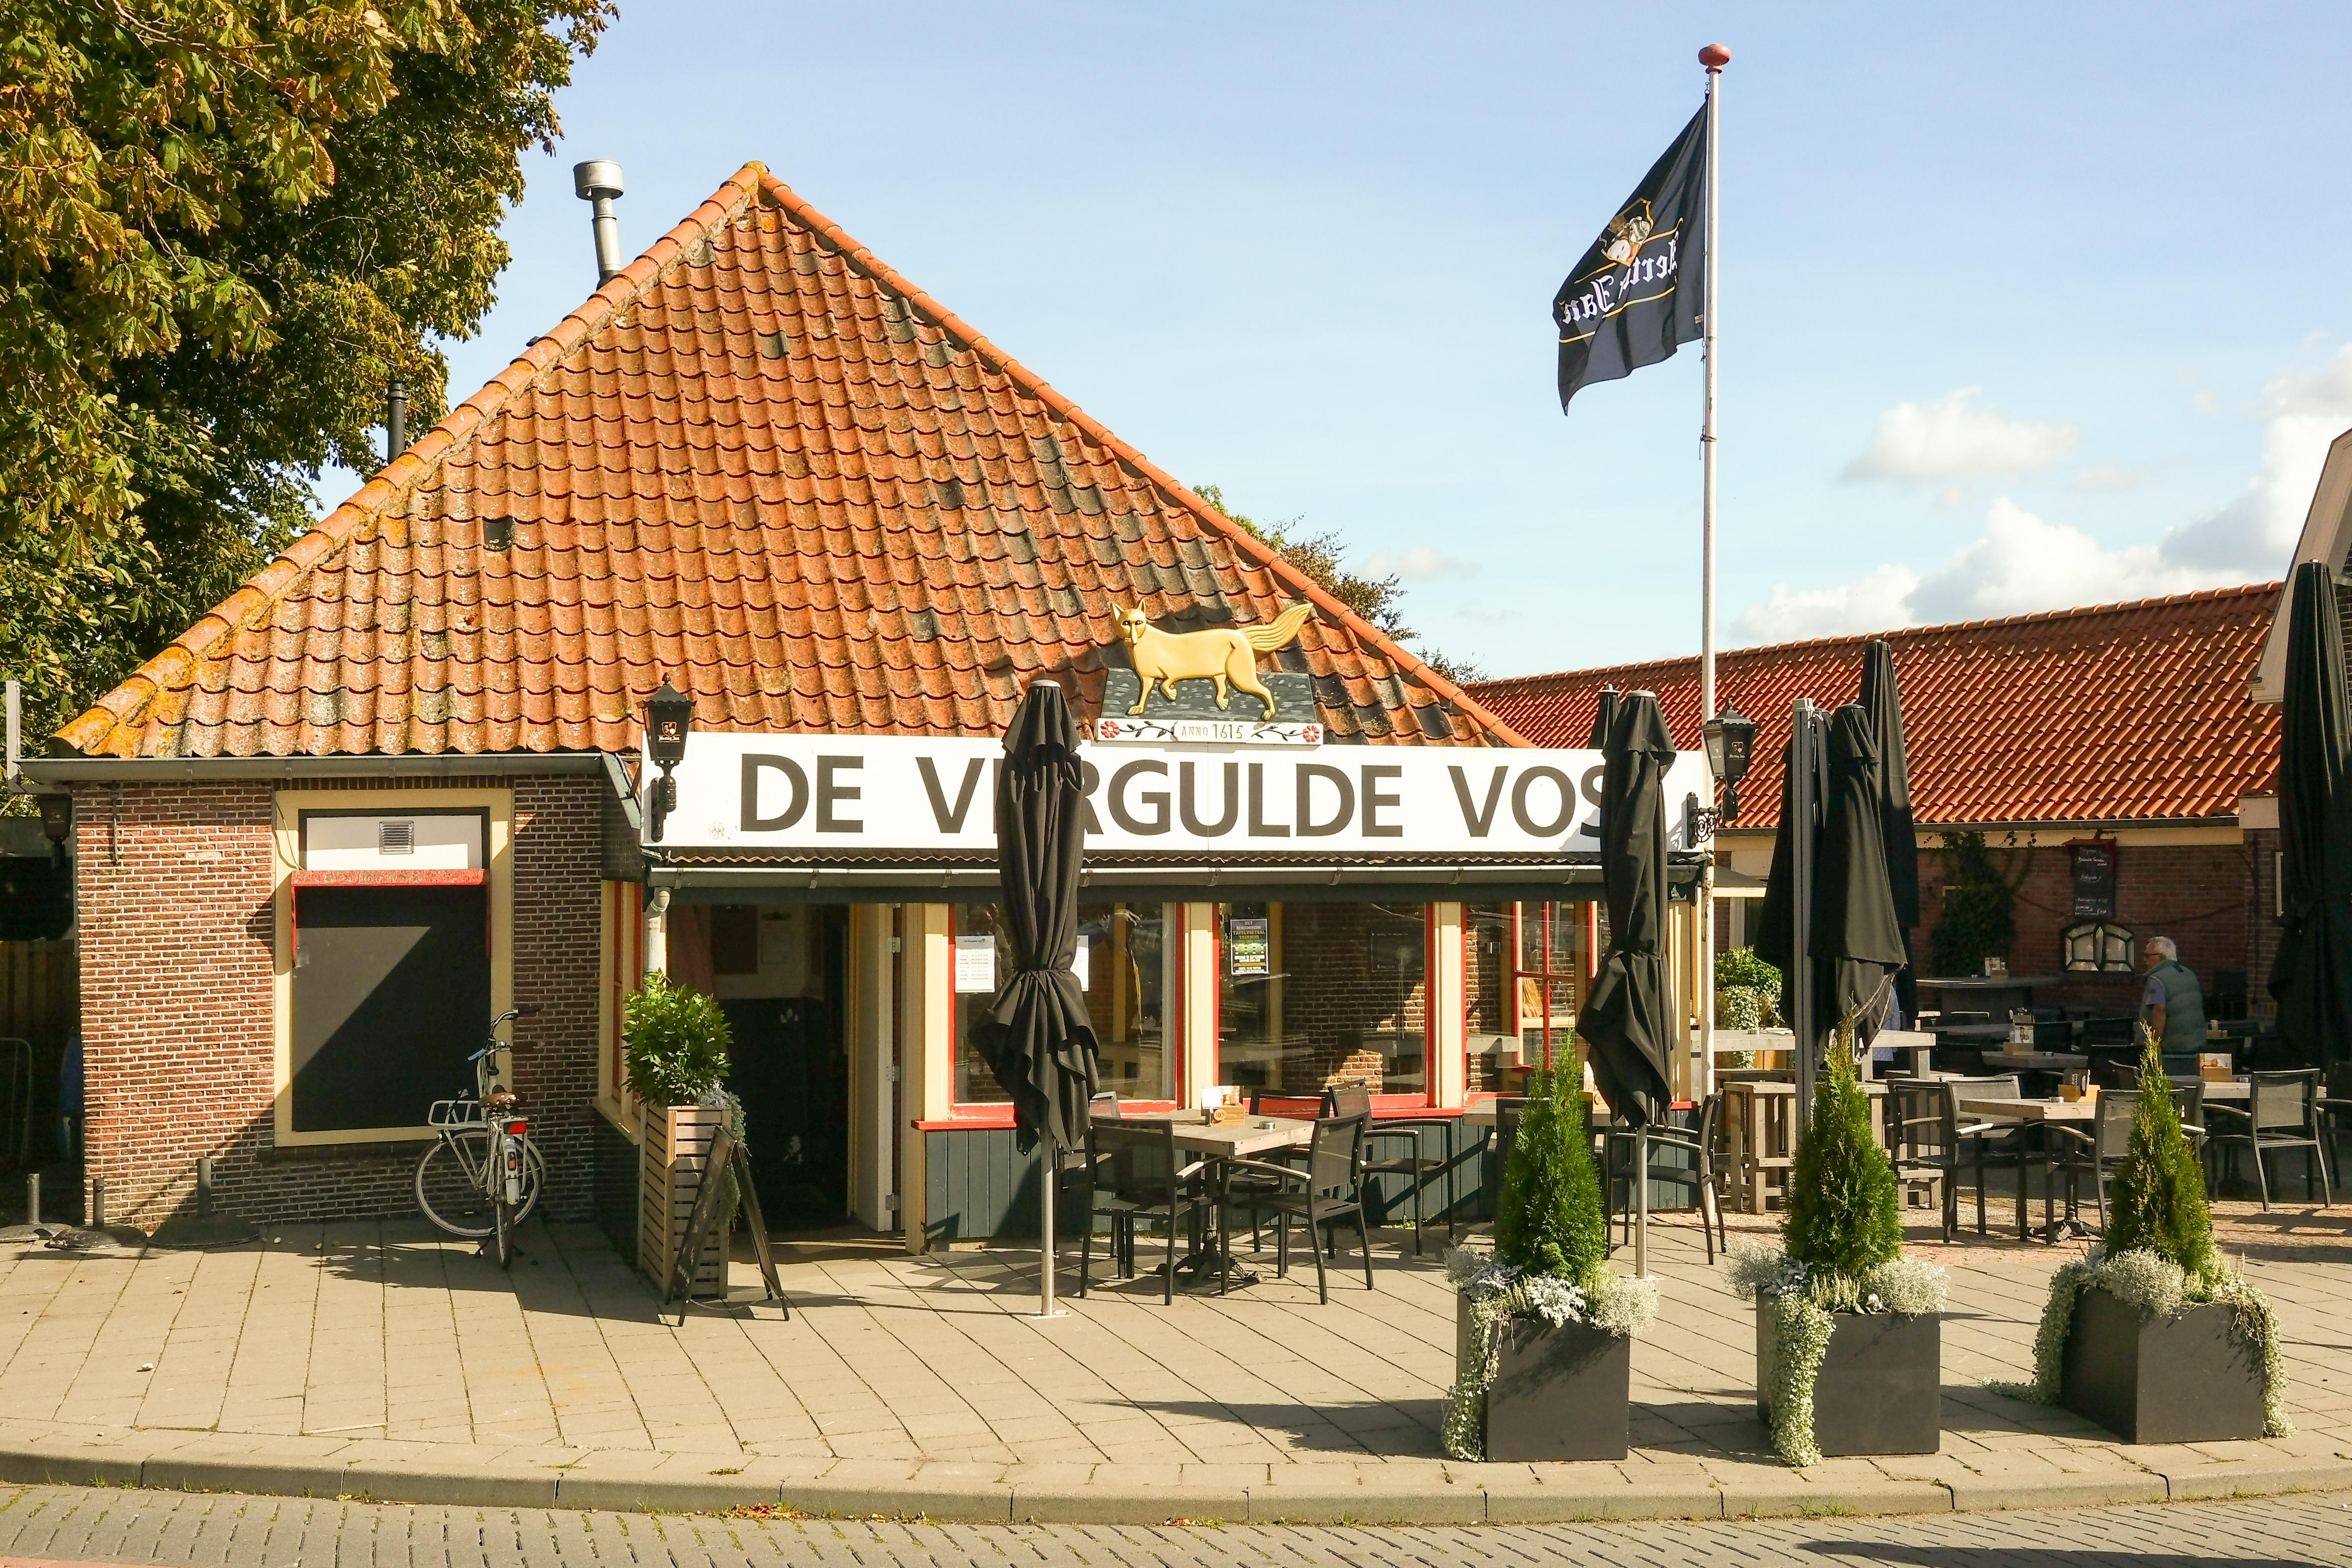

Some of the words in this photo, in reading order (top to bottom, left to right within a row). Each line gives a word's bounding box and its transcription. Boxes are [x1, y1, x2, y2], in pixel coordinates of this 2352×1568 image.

[1182, 726, 1208, 737] ANNO
[1212, 724, 1243, 740] 1615
[741, 753, 864, 833] DE
[916, 756, 1403, 838] VRGULDE
